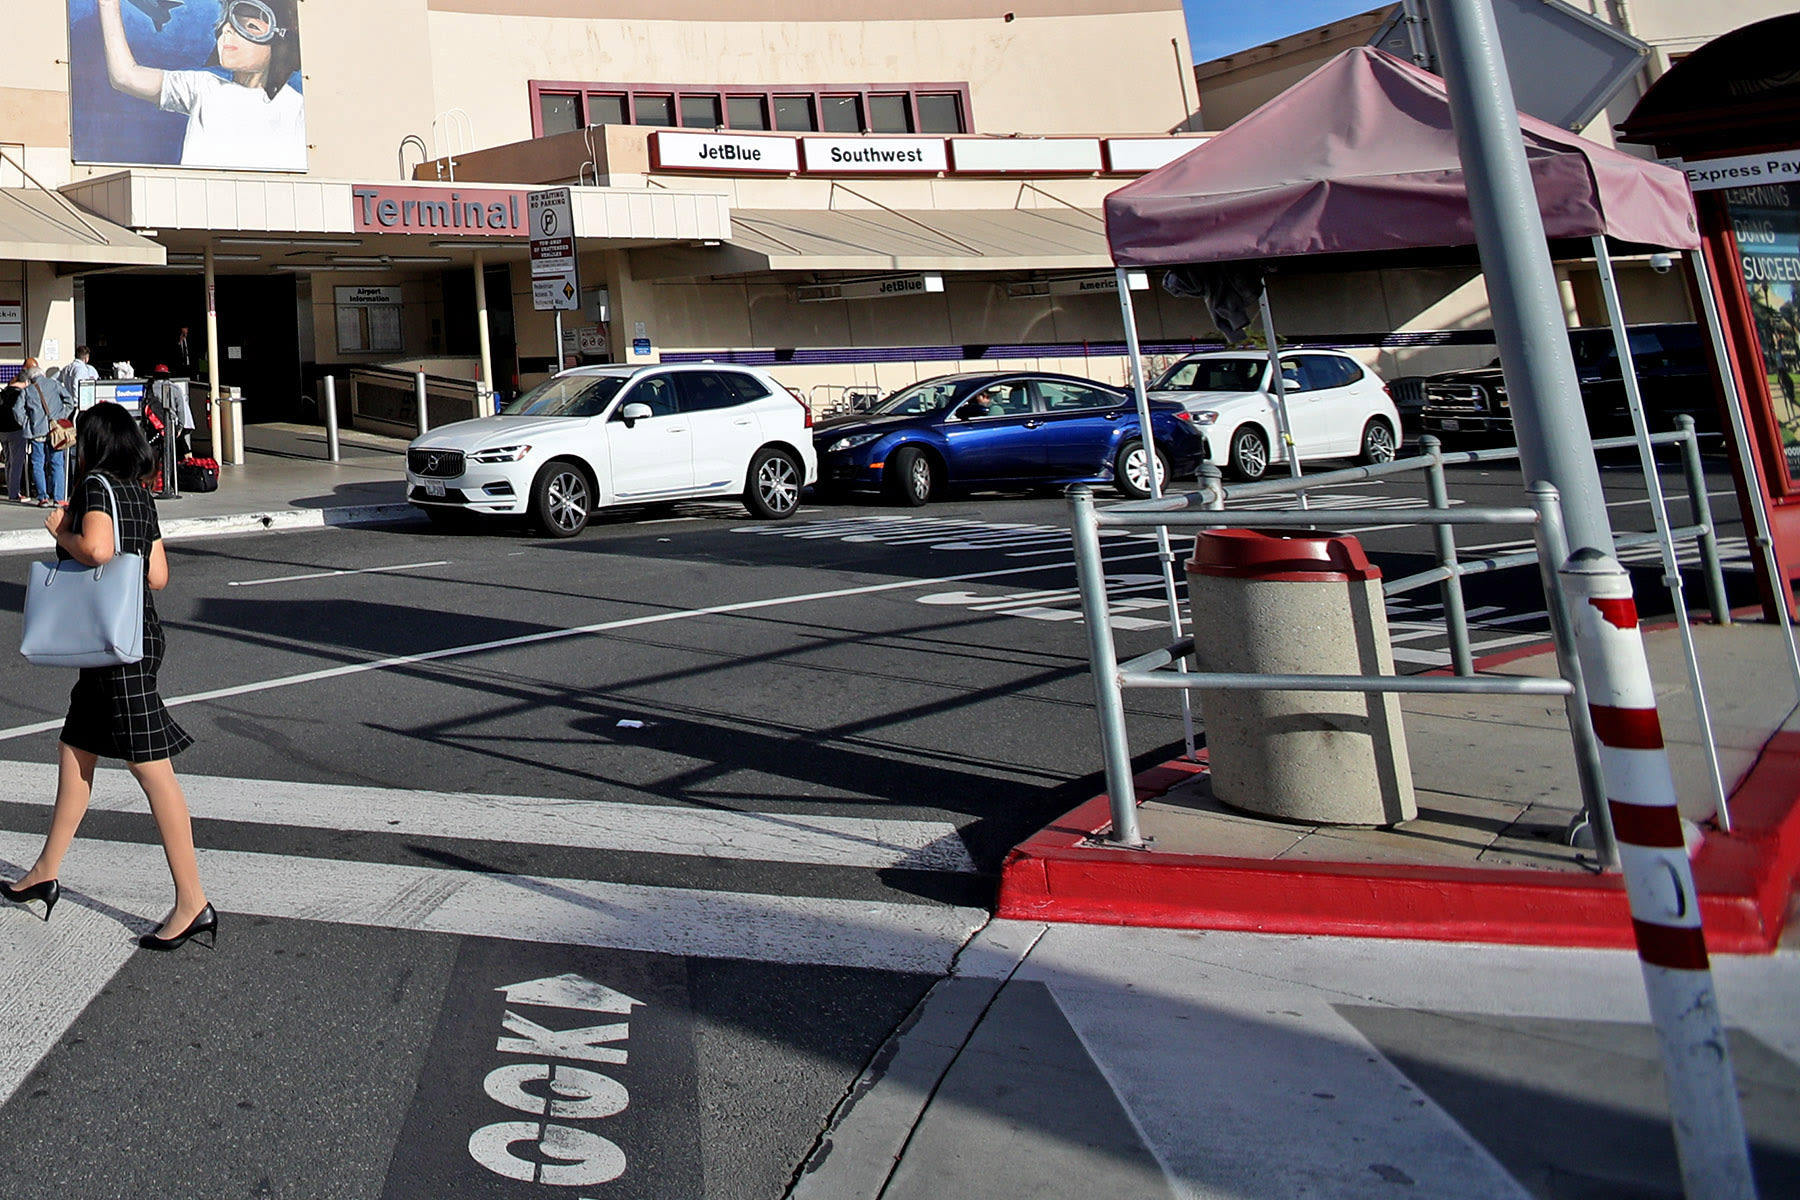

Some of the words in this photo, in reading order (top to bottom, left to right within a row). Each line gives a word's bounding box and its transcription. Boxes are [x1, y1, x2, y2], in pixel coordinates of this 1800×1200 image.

[698, 142, 762, 161] JetBlue
[830, 145, 924, 164] Southwest
[1687, 166, 1761, 183] Express
[540, 190, 564, 200] WAITING
[540, 198, 566, 208] PARKING
[1725, 184, 1790, 207] LEARNING
[353, 189, 519, 230] Terminal
[1734, 219, 1776, 244] DOING
[1742, 256, 1800, 281] SUCCEED
[357, 288, 382, 296] Airport
[880, 279, 922, 293] JetBlue
